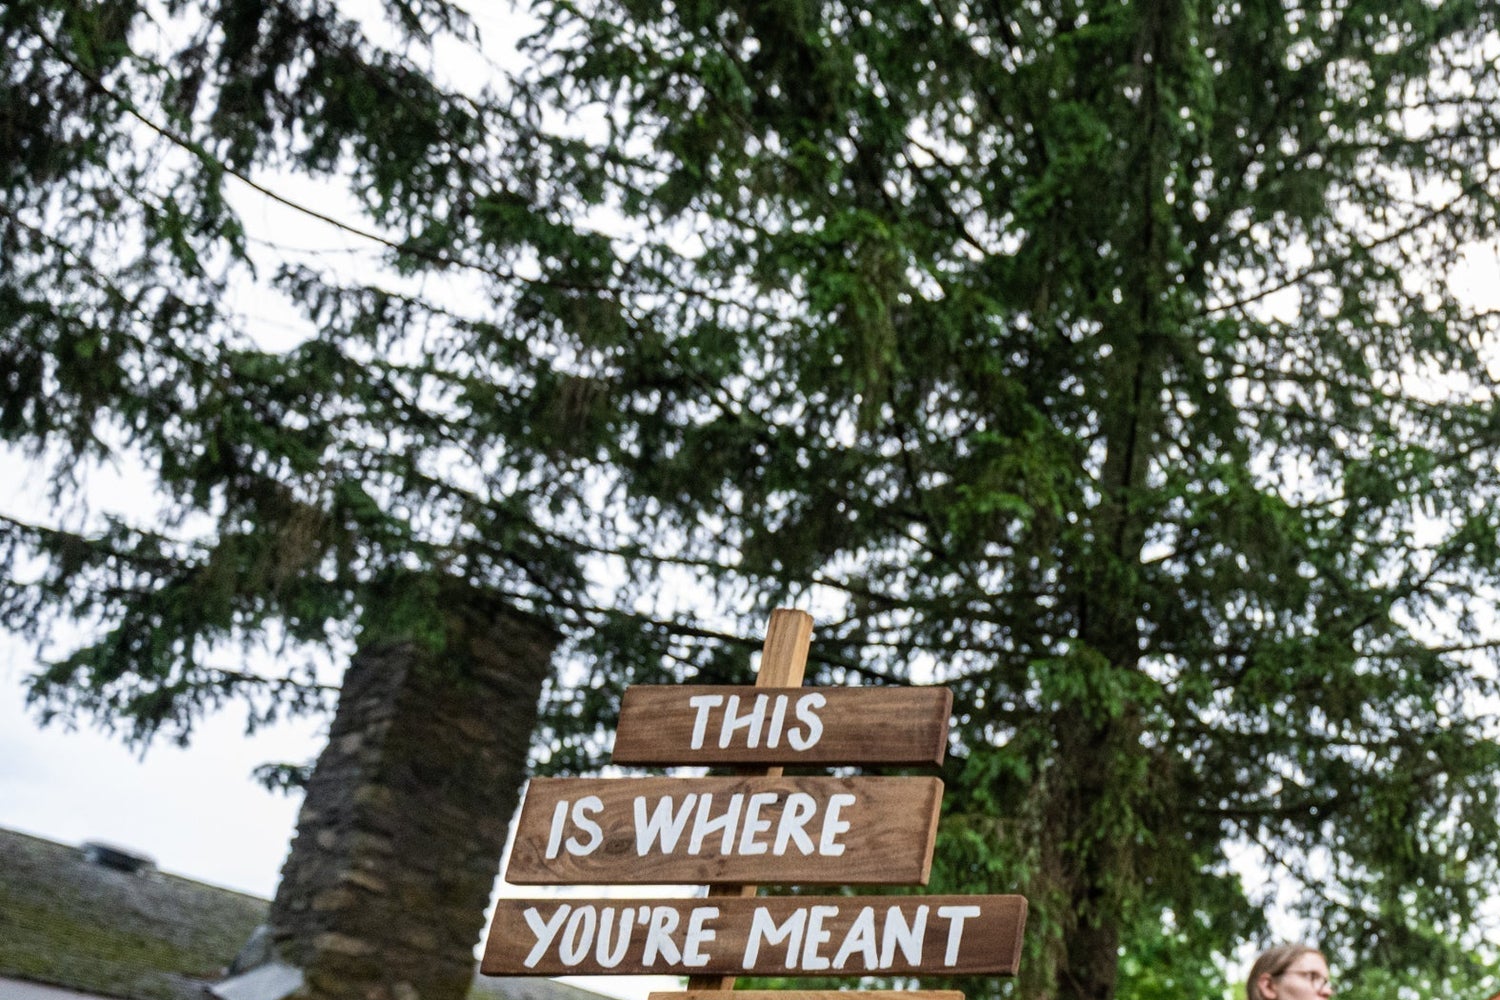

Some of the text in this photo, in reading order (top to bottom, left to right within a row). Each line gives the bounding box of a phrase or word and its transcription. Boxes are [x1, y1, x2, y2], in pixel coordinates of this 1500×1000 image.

[689, 693, 827, 751] THIS
[545, 792, 857, 859] IS WHERE
[523, 904, 981, 970] YOU'RE MEANT
